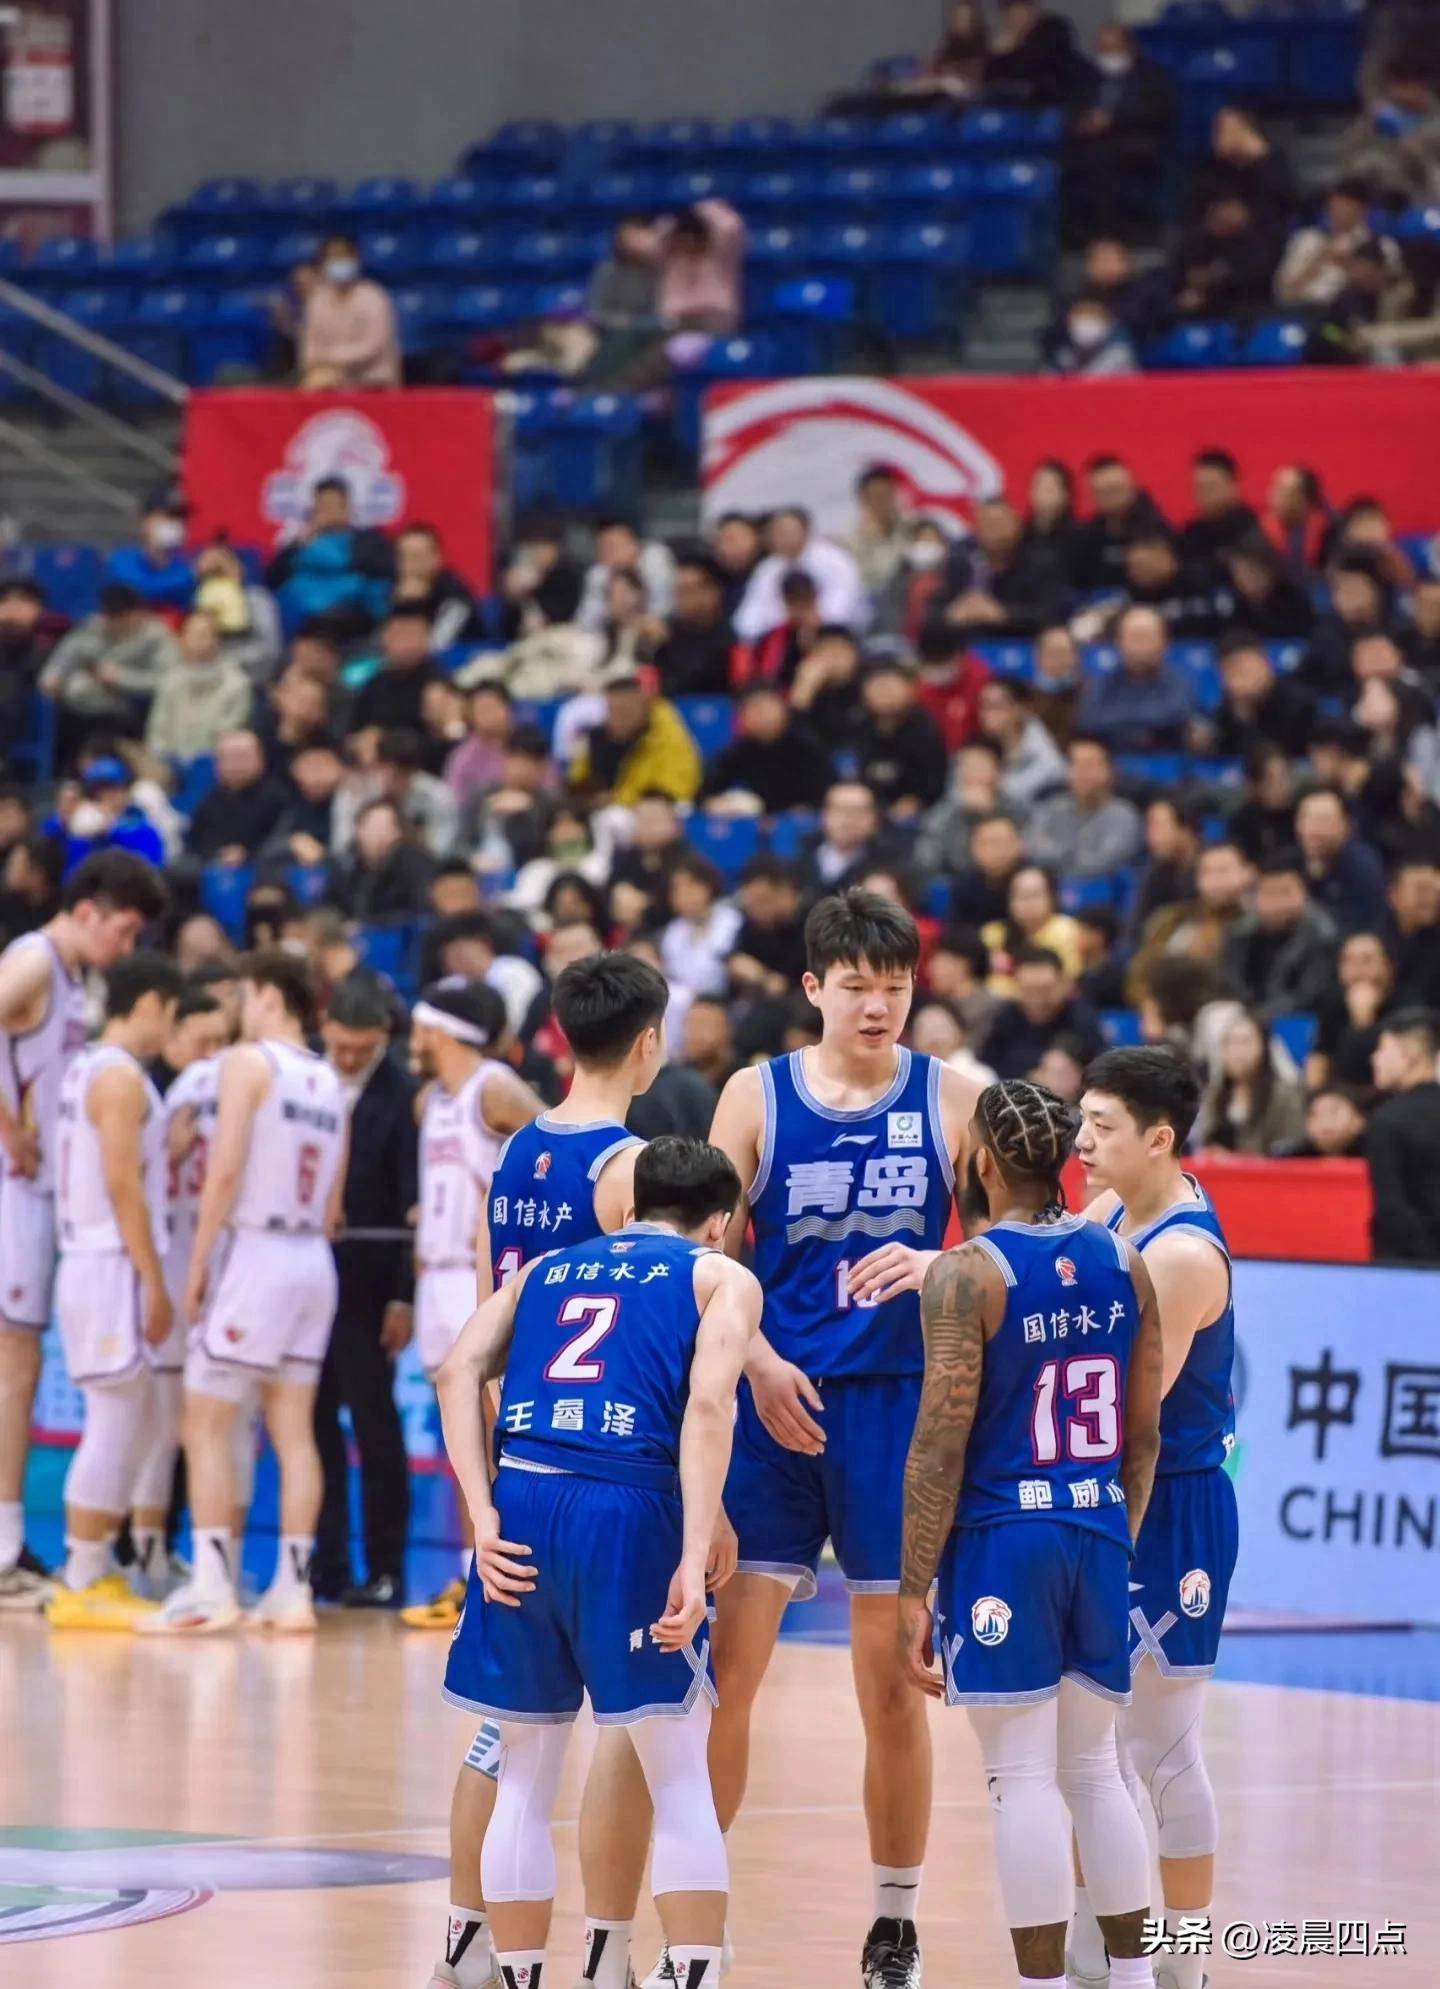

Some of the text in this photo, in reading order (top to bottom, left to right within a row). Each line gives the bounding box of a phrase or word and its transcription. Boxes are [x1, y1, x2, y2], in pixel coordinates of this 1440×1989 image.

[785, 1155, 929, 1216] 青岛
[493, 1196, 573, 1233] 国信水产
[544, 1261, 671, 1286] 国信水产
[835, 1256, 884, 1311] 1
[543, 1294, 620, 1384] 2
[1023, 1300, 1126, 1344] 国信水产
[505, 1398, 637, 1437] 王睿泽
[1031, 1354, 1121, 1466] 13
[1286, 1346, 1440, 1460] 中国
